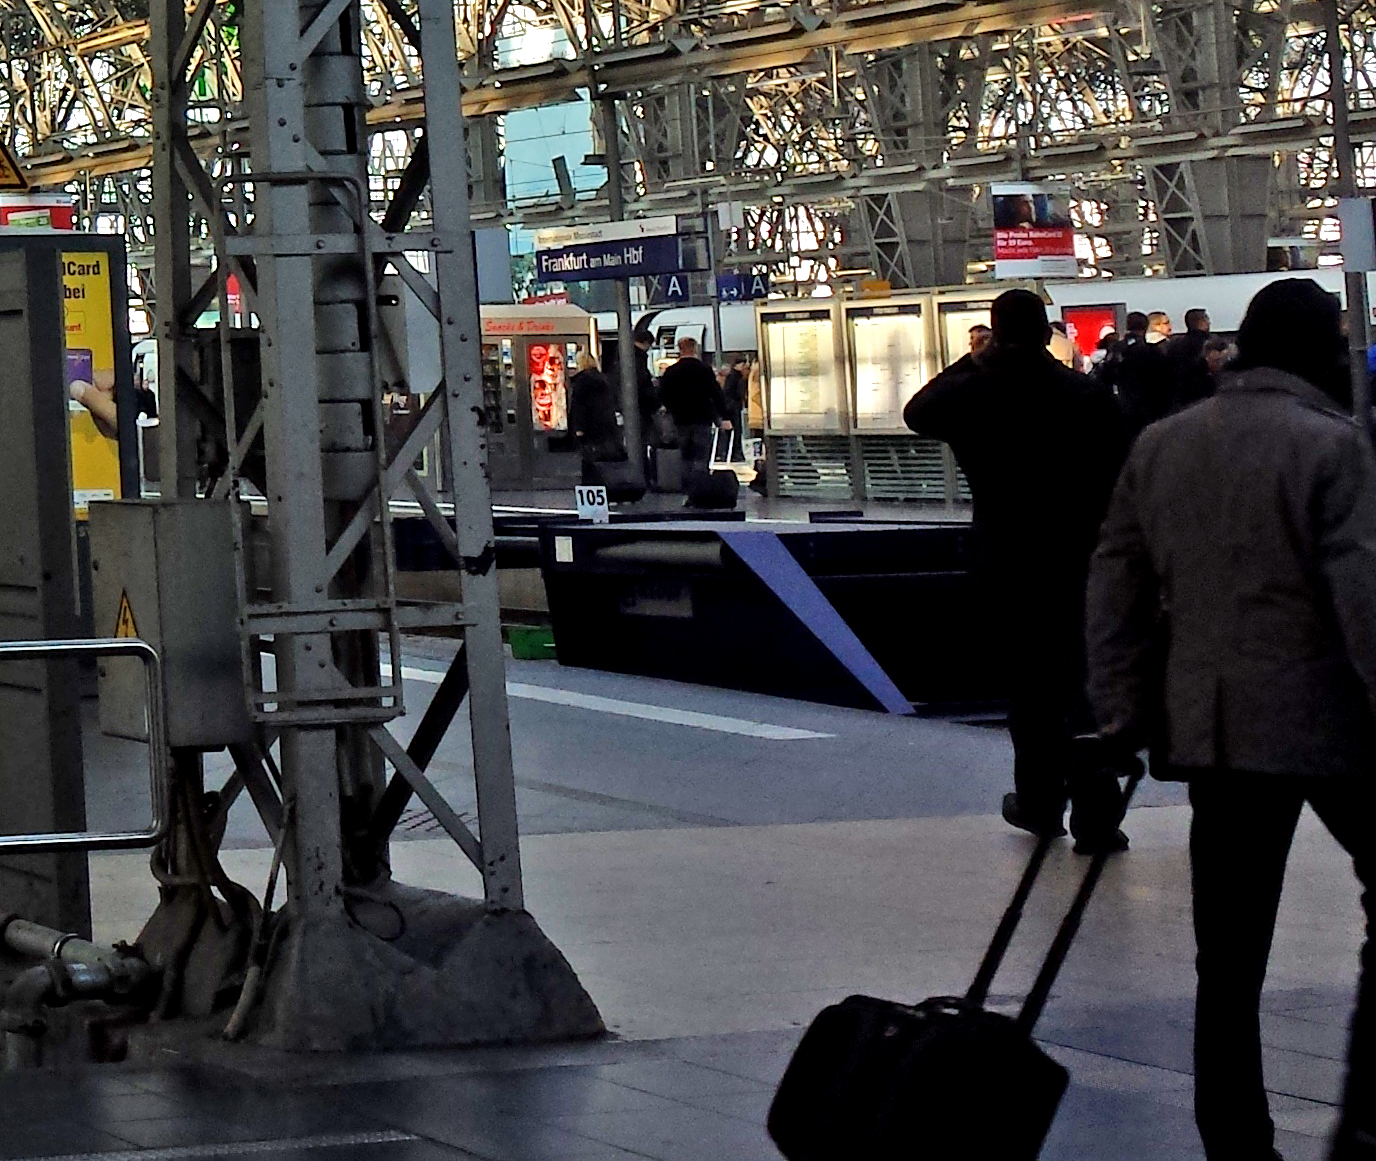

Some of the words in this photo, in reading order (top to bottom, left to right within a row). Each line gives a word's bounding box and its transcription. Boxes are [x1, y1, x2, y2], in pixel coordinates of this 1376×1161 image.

[542, 252, 589, 273] Frankfurt
[589, 256, 602, 269] am
[603, 253, 623, 267] Main
[624, 245, 644, 265] Hbf
[667, 275, 683, 297] A
[751, 276, 766, 295] A
[578, 489, 605, 506] 105
